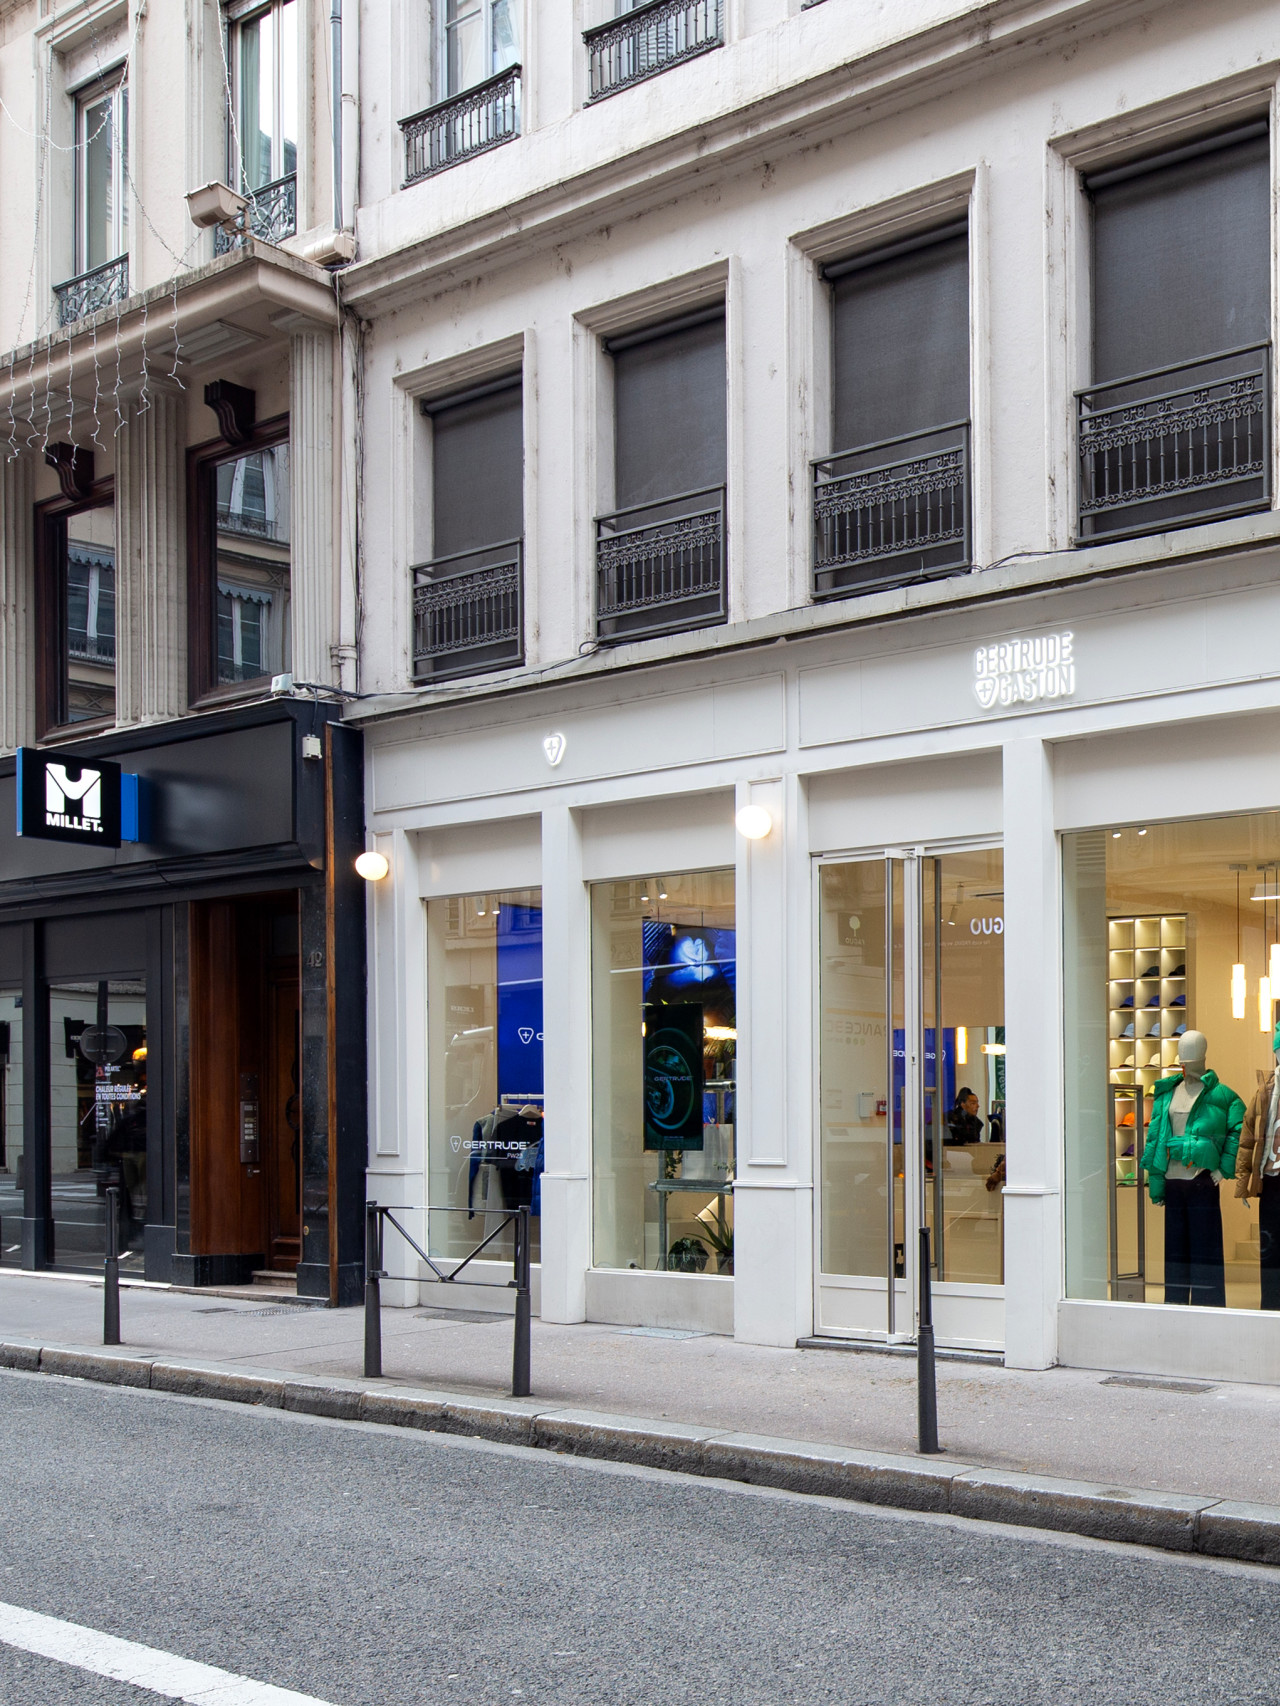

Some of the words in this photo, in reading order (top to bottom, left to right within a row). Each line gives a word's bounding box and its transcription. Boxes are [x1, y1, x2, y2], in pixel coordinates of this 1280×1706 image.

[975, 632, 1074, 679] GERTRUDE
[999, 664, 1075, 704] GASTON
[306, 951, 323, 967] 42
